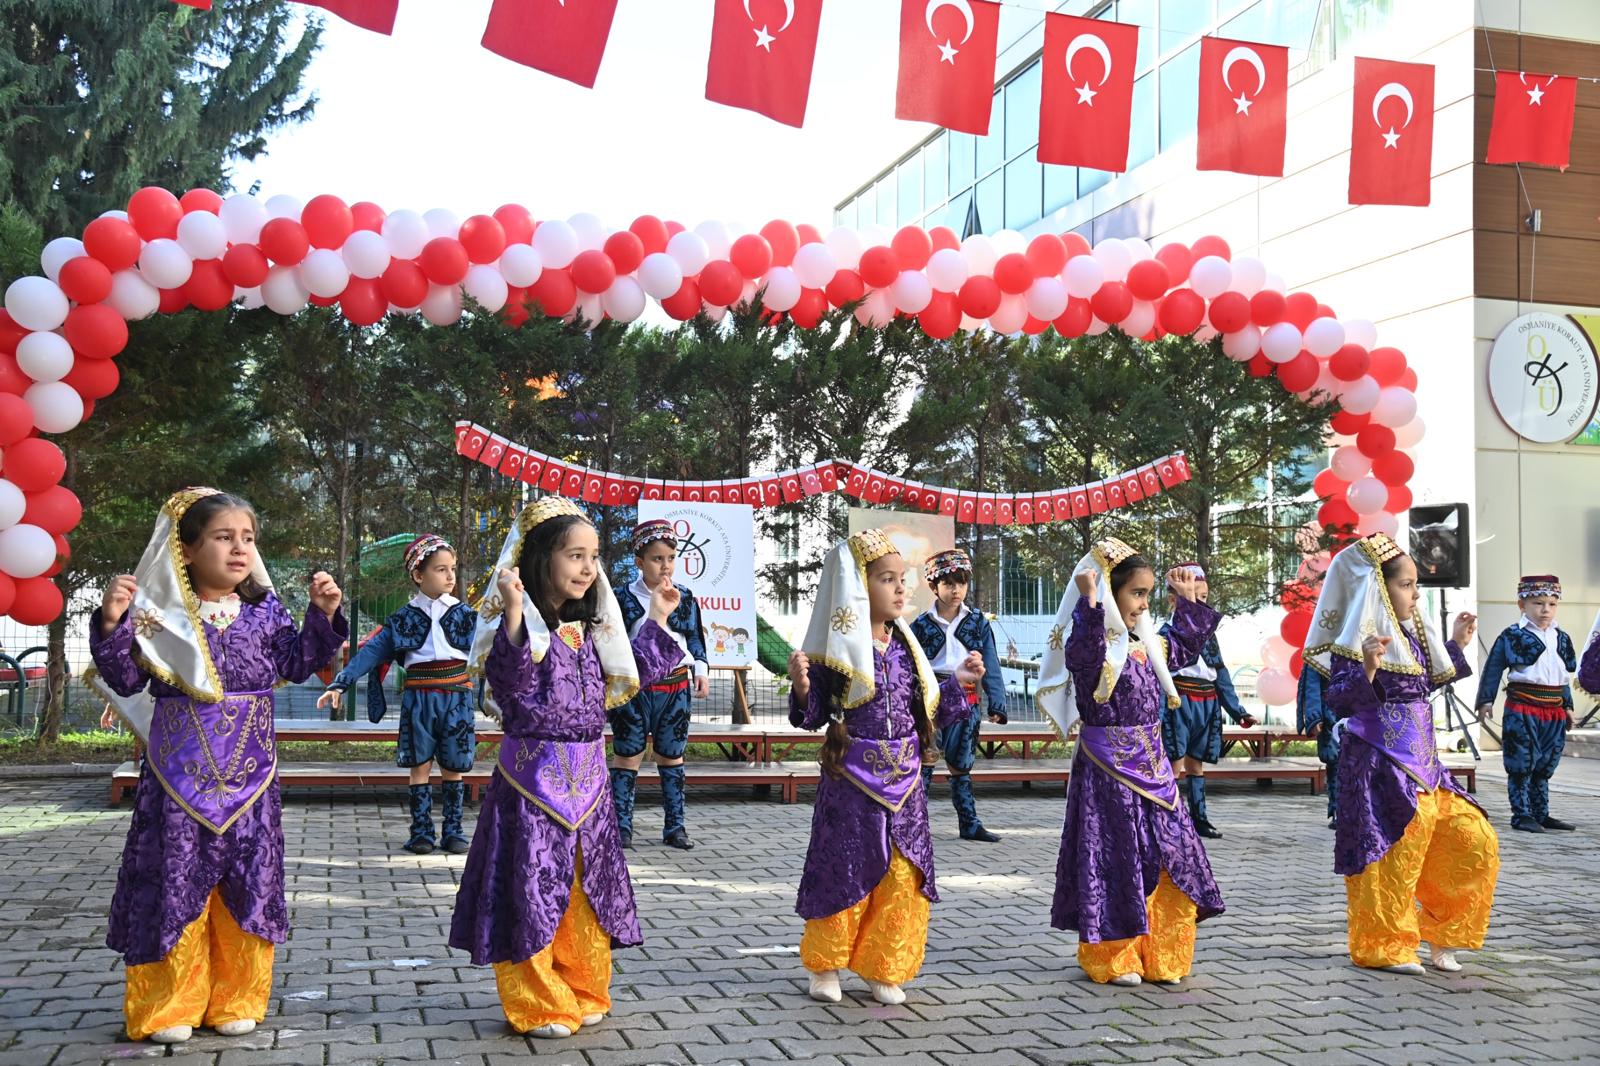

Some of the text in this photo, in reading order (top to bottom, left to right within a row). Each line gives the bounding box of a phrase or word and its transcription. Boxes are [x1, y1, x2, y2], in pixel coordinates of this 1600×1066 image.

[1556, 326, 1583, 352] KORKUT
[700, 512, 723, 531] KORKUT
[694, 597, 741, 611] KULU
